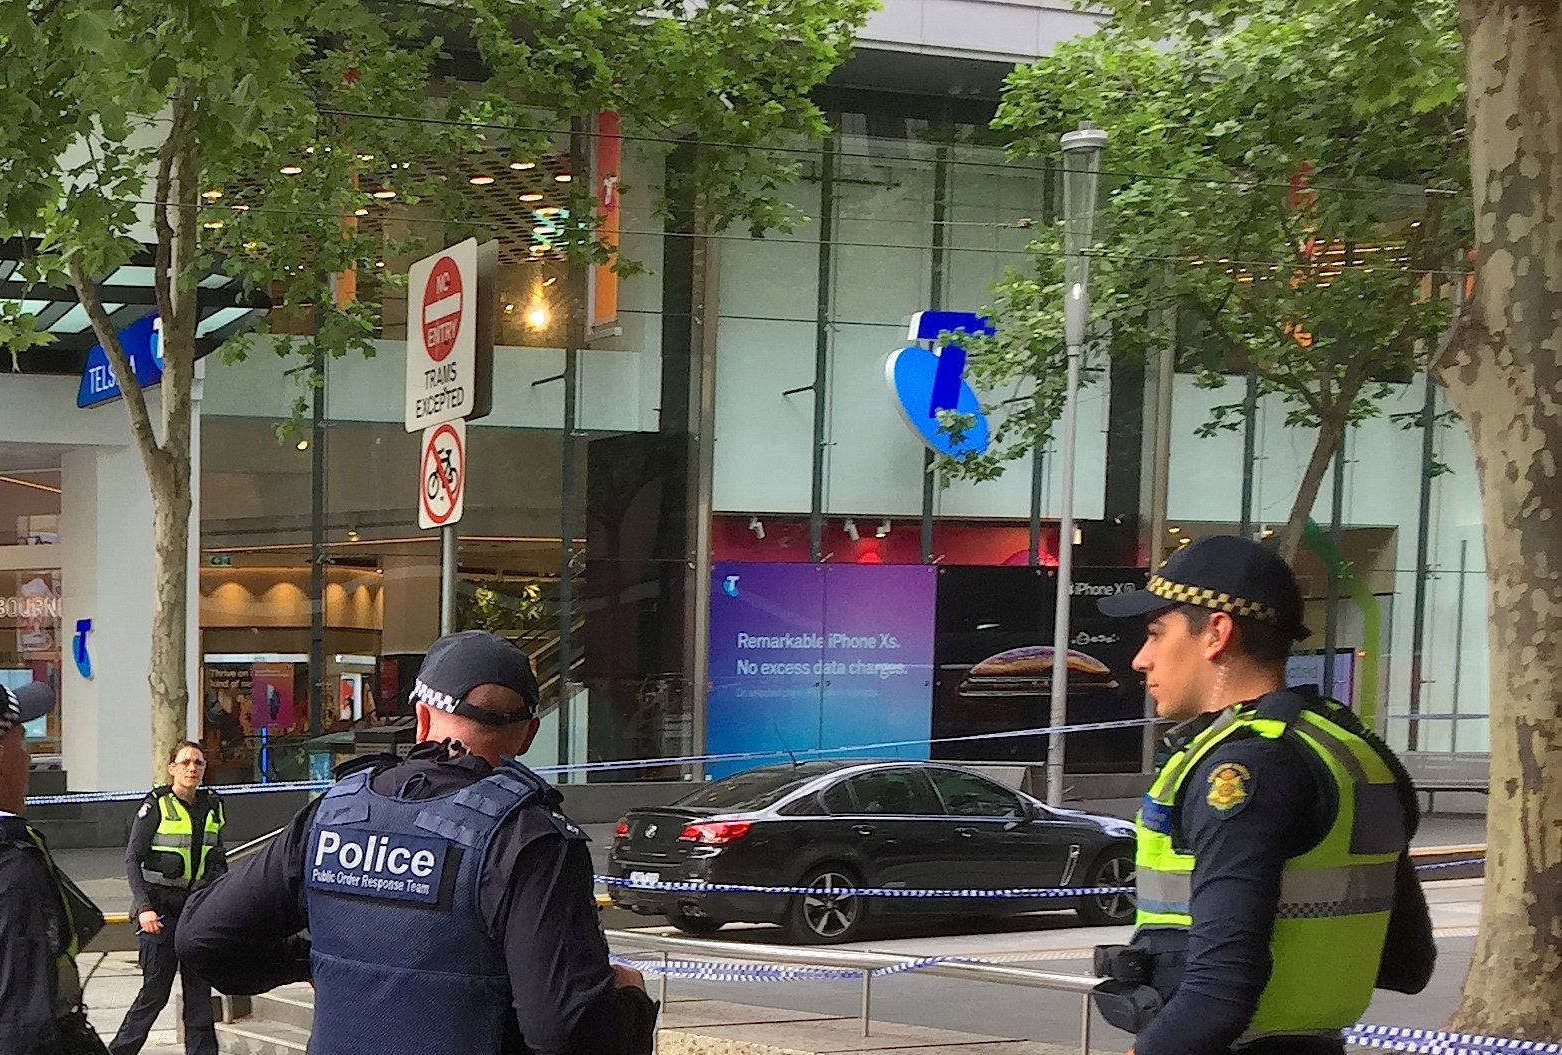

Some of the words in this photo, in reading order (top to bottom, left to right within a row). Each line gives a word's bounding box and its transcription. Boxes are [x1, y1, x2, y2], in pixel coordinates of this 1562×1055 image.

[427, 319, 458, 348] ENTRY
[425, 362, 457, 390] TRAMS
[416, 387, 464, 418] EXCEPTED
[1075, 583, 1114, 596] iPhone
[738, 632, 824, 649] Remarkable
[828, 633, 876, 649] iPhone
[737, 660, 759, 675] No
[761, 663, 810, 676] excess
[814, 659, 845, 675] data
[849, 660, 908, 679] charges.
[315, 830, 435, 877] Police
[312, 869, 336, 883] Public
[337, 871, 361, 888] Order
[361, 874, 404, 891] Response
[406, 879, 430, 895] Team
